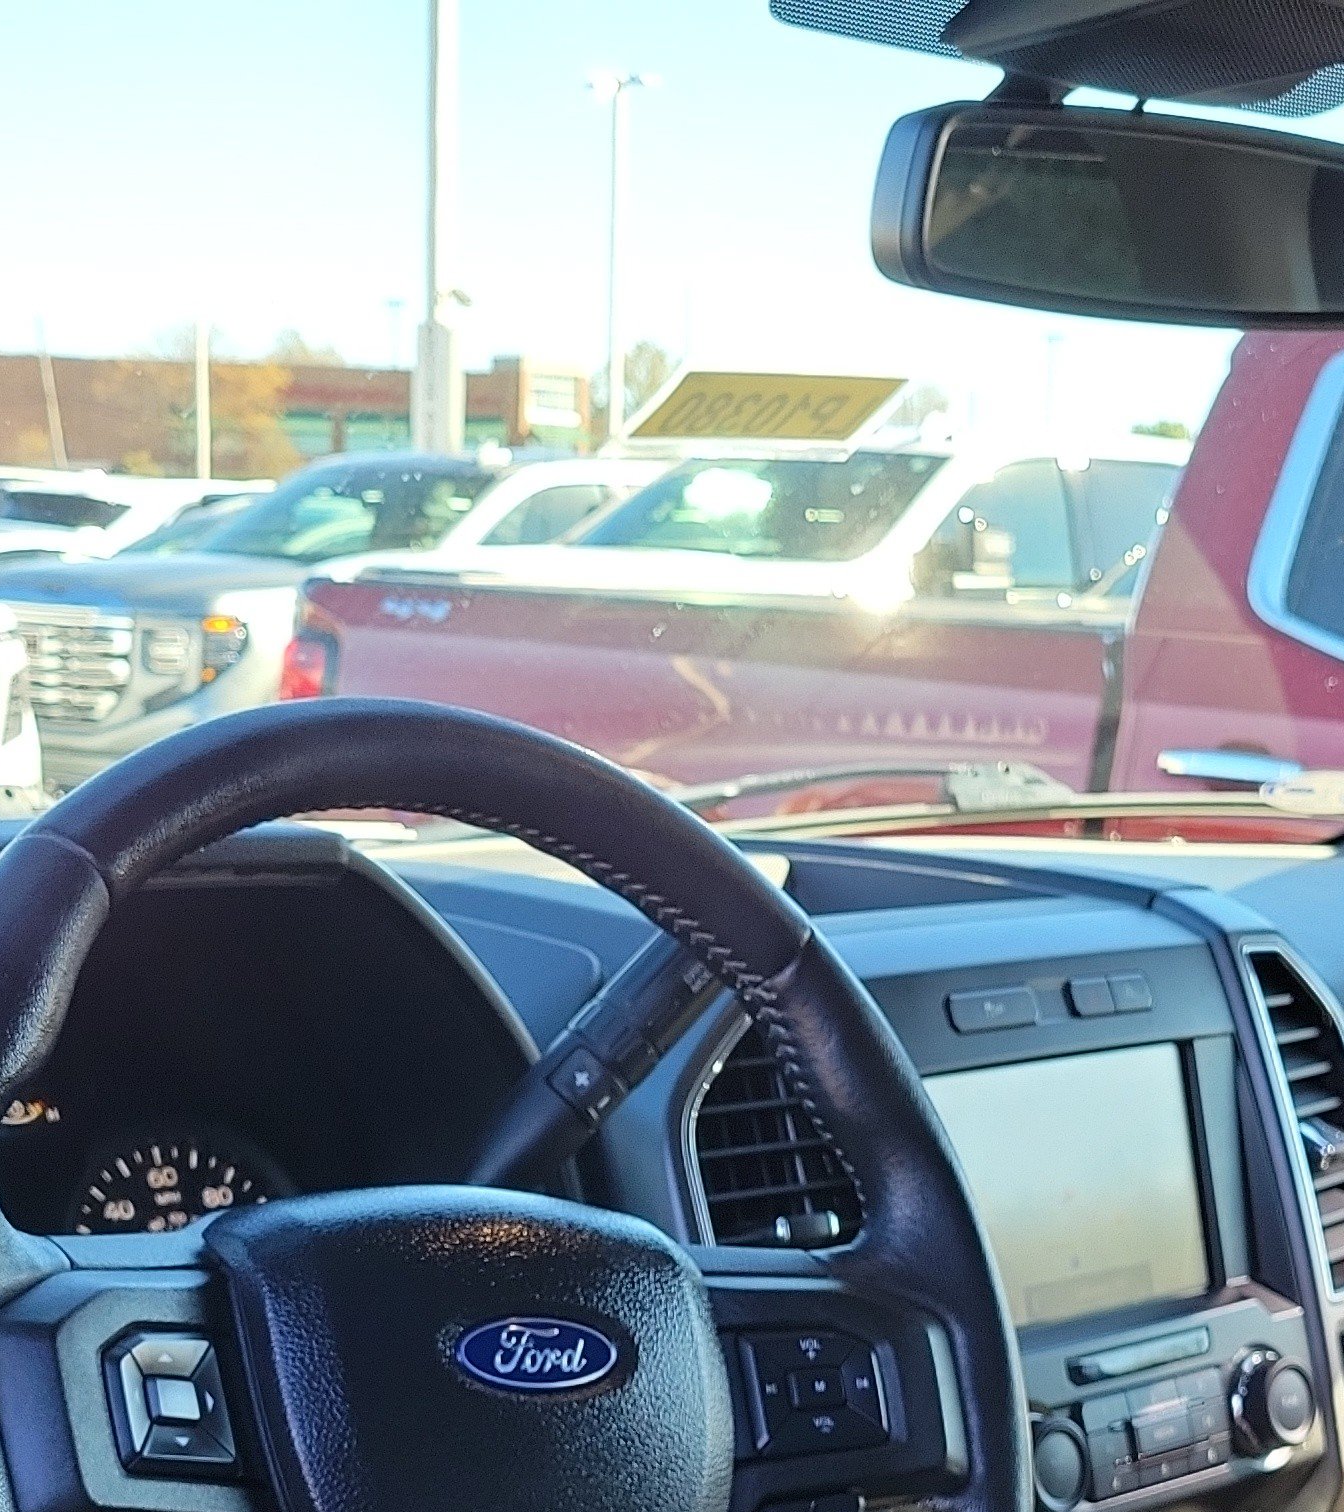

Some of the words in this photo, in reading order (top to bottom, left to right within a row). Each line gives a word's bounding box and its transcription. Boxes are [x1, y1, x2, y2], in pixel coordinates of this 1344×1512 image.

[147, 1164, 179, 1189] 60
[103, 1198, 136, 1222] 40
[493, 1323, 588, 1374] Ford
